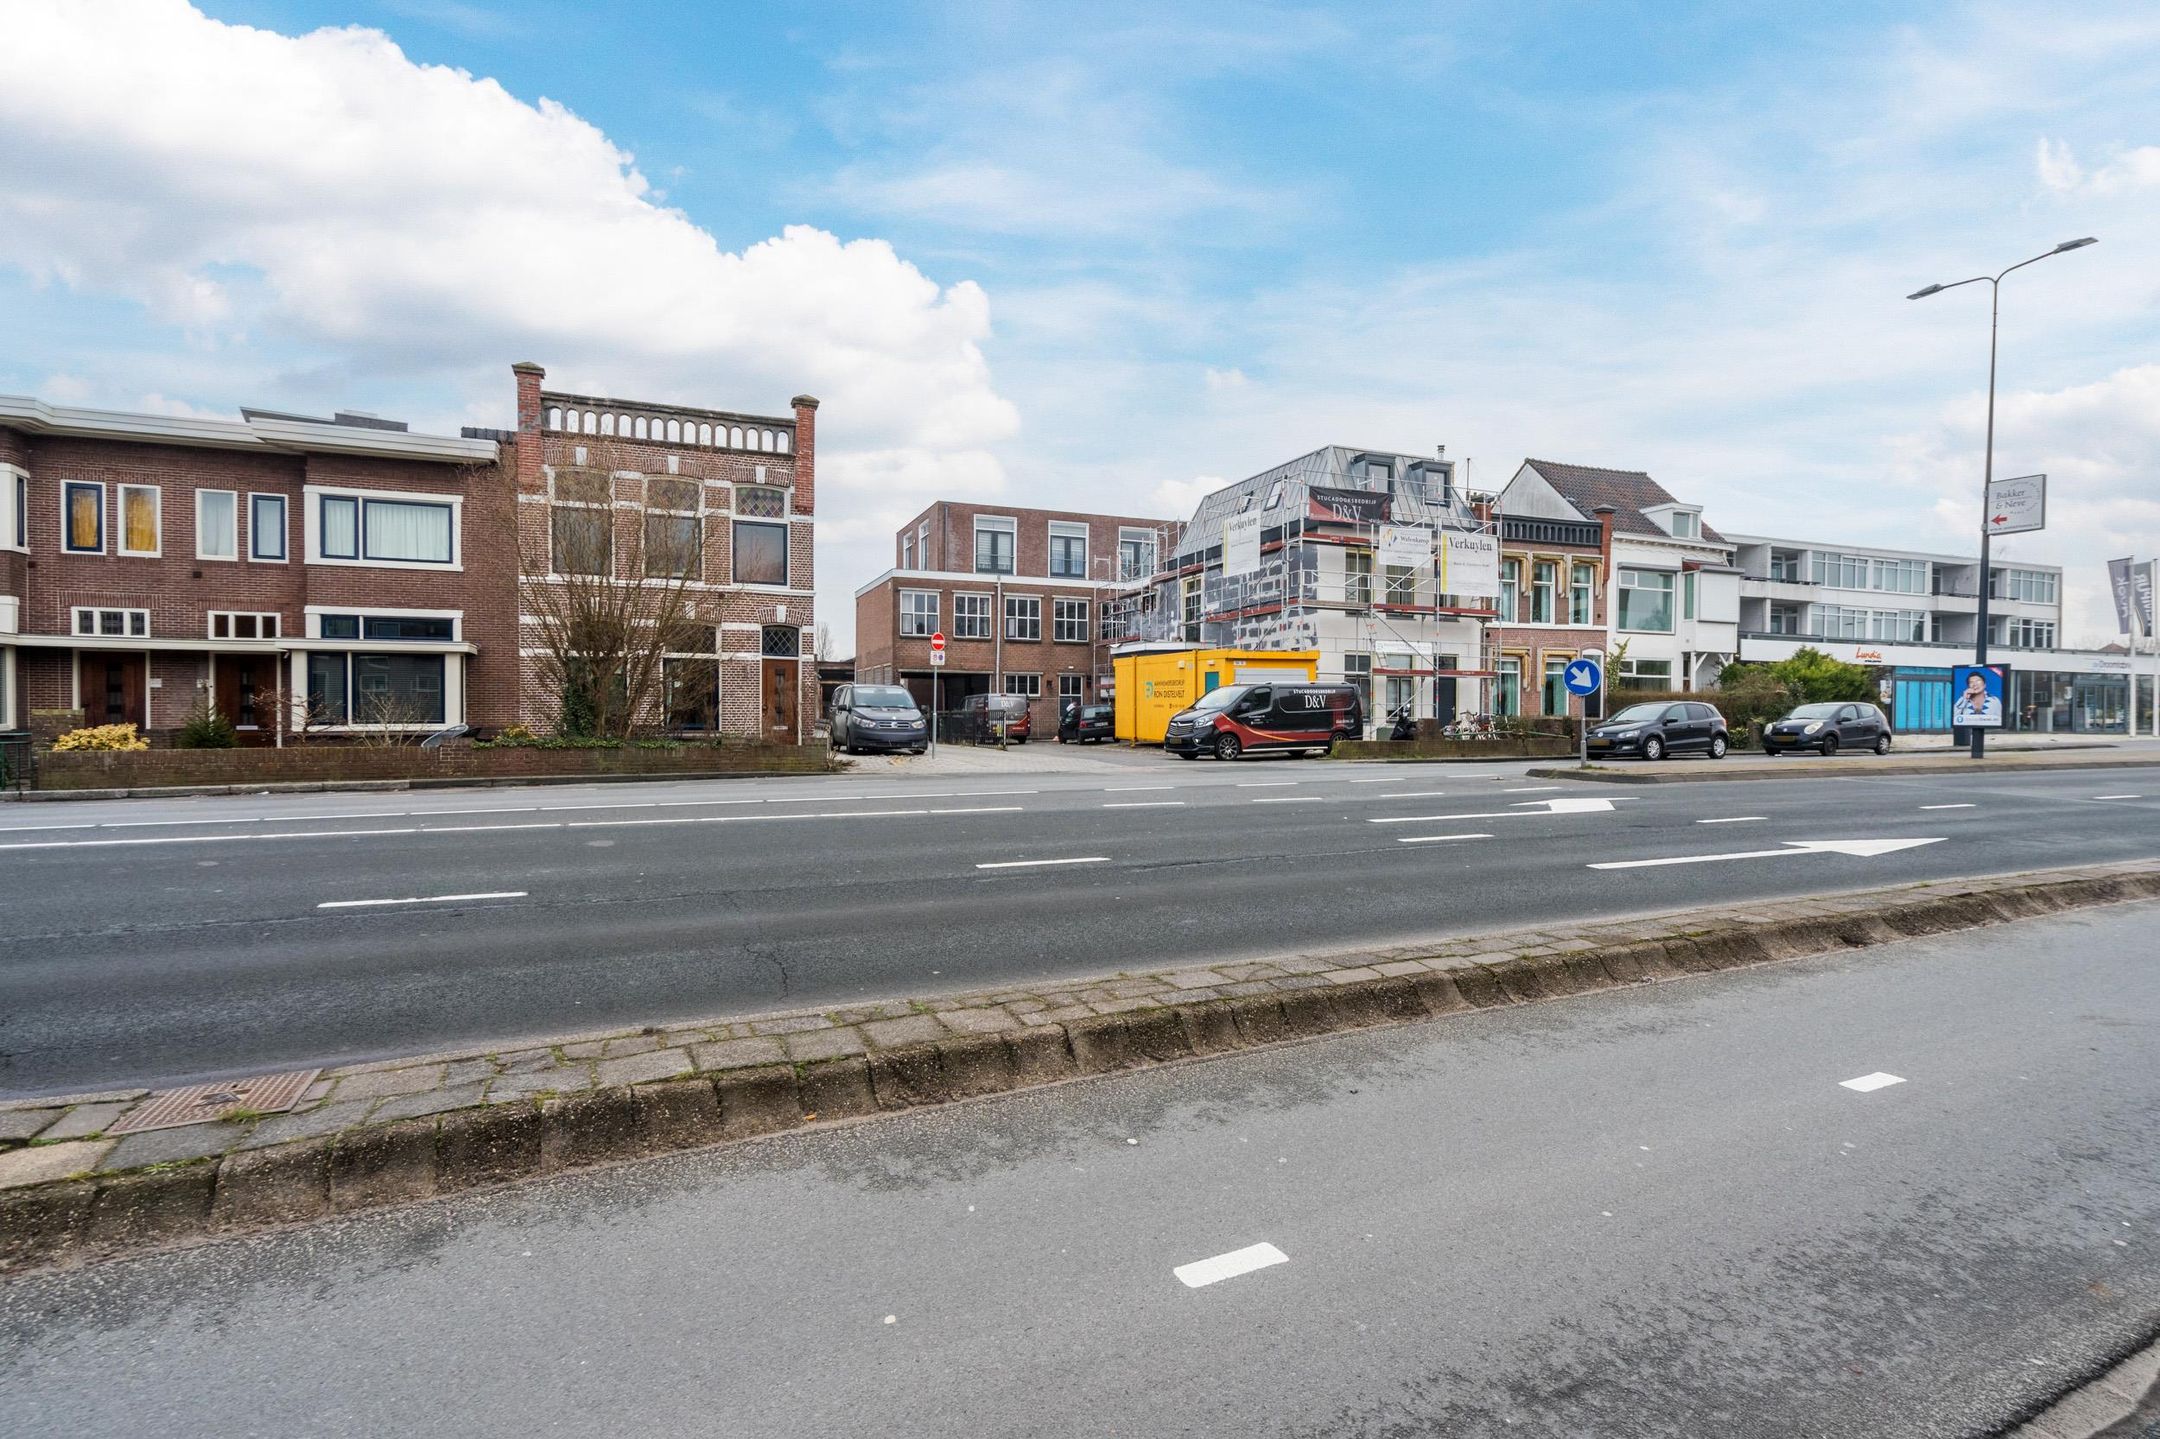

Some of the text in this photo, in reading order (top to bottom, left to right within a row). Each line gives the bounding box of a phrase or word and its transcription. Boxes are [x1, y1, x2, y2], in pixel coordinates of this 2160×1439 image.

[1996, 489, 2025, 500] Bakker
[2004, 500, 2026, 509] Neve
[1332, 503, 1361, 522] D&V
[1449, 537, 1492, 553] Verkuylen
[1304, 694, 1326, 709] D&V
